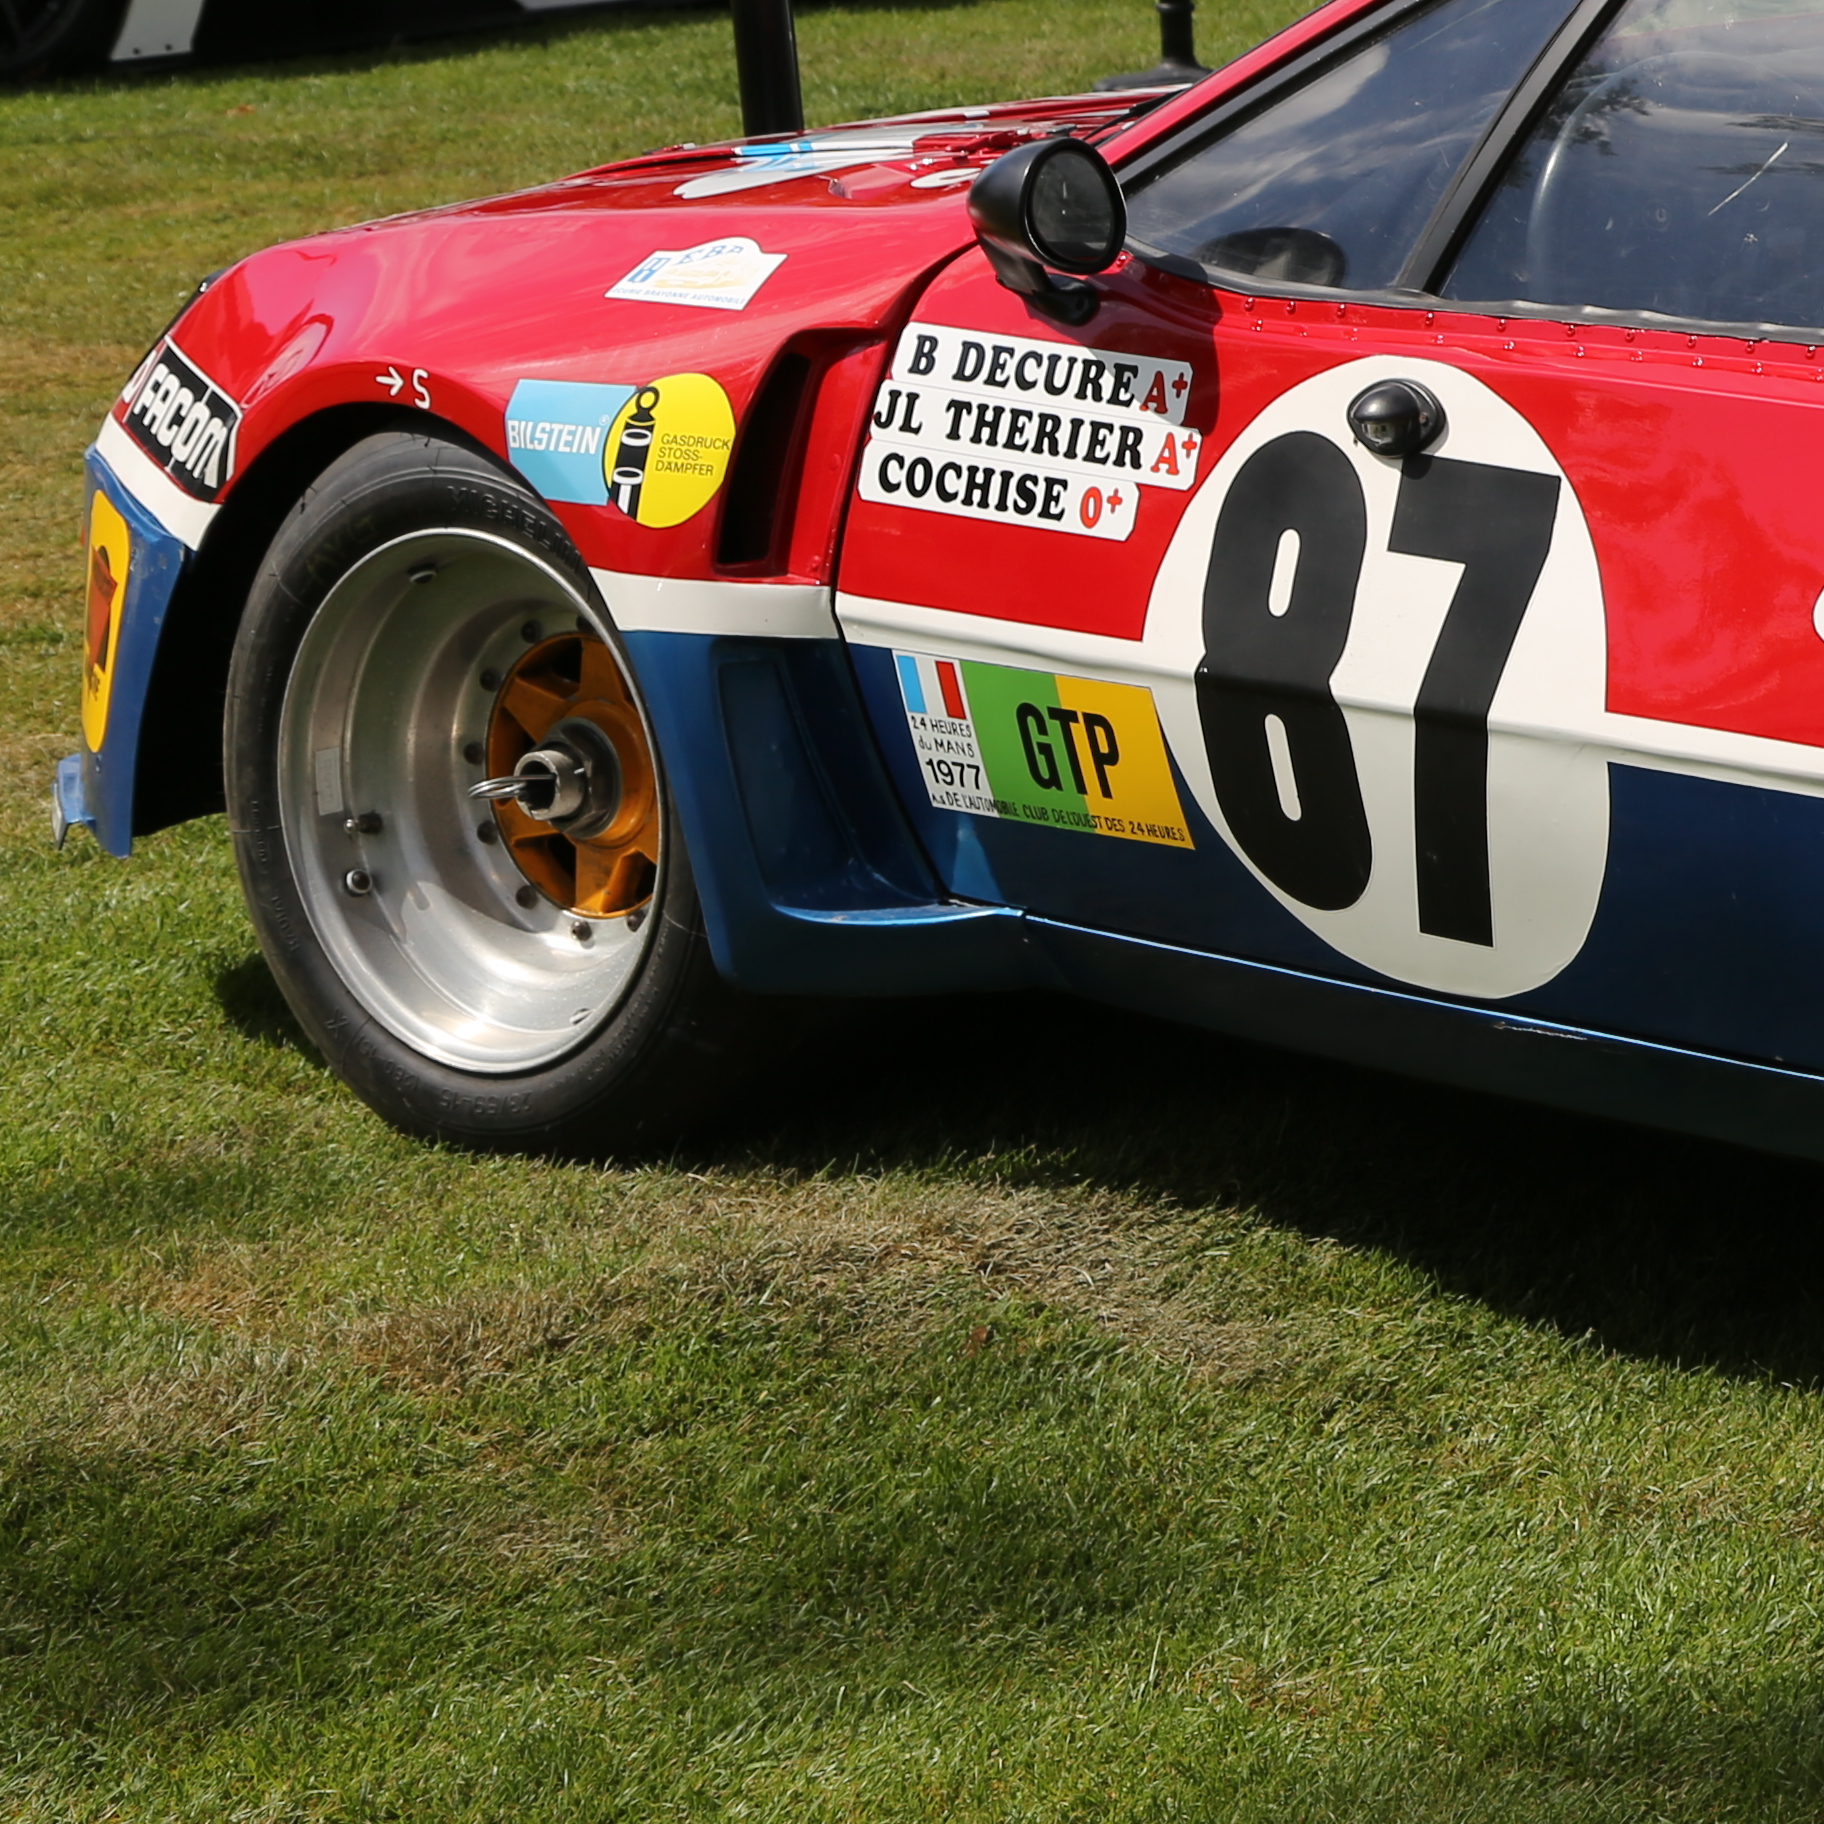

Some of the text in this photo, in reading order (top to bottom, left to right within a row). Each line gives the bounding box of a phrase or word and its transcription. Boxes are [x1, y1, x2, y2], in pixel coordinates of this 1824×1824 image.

[908, 333, 938, 376] B
[951, 340, 1140, 409] DECURE
[132, 362, 228, 489] FACOM
[507, 419, 602, 455] BILSTEIN
[660, 432, 731, 452] GASDRUCK
[873, 389, 922, 435] JL
[944, 399, 1144, 470] THERIER
[654, 459, 715, 477] DÄMPFER
[657, 446, 703, 462] STOSS-
[877, 451, 1068, 522] COCHISE
[446, 484, 582, 574] MICHELIN
[1195, 430, 1562, 948] 87
[910, 715, 973, 739] 24 HEURES
[918, 736, 975, 759] du MANS
[1014, 701, 1120, 800] GTP
[925, 758, 981, 791] 1977
[1022, 803, 1051, 822] CLUB
[1104, 816, 1125, 834] DES
[1145, 823, 1186, 843] HEURES
